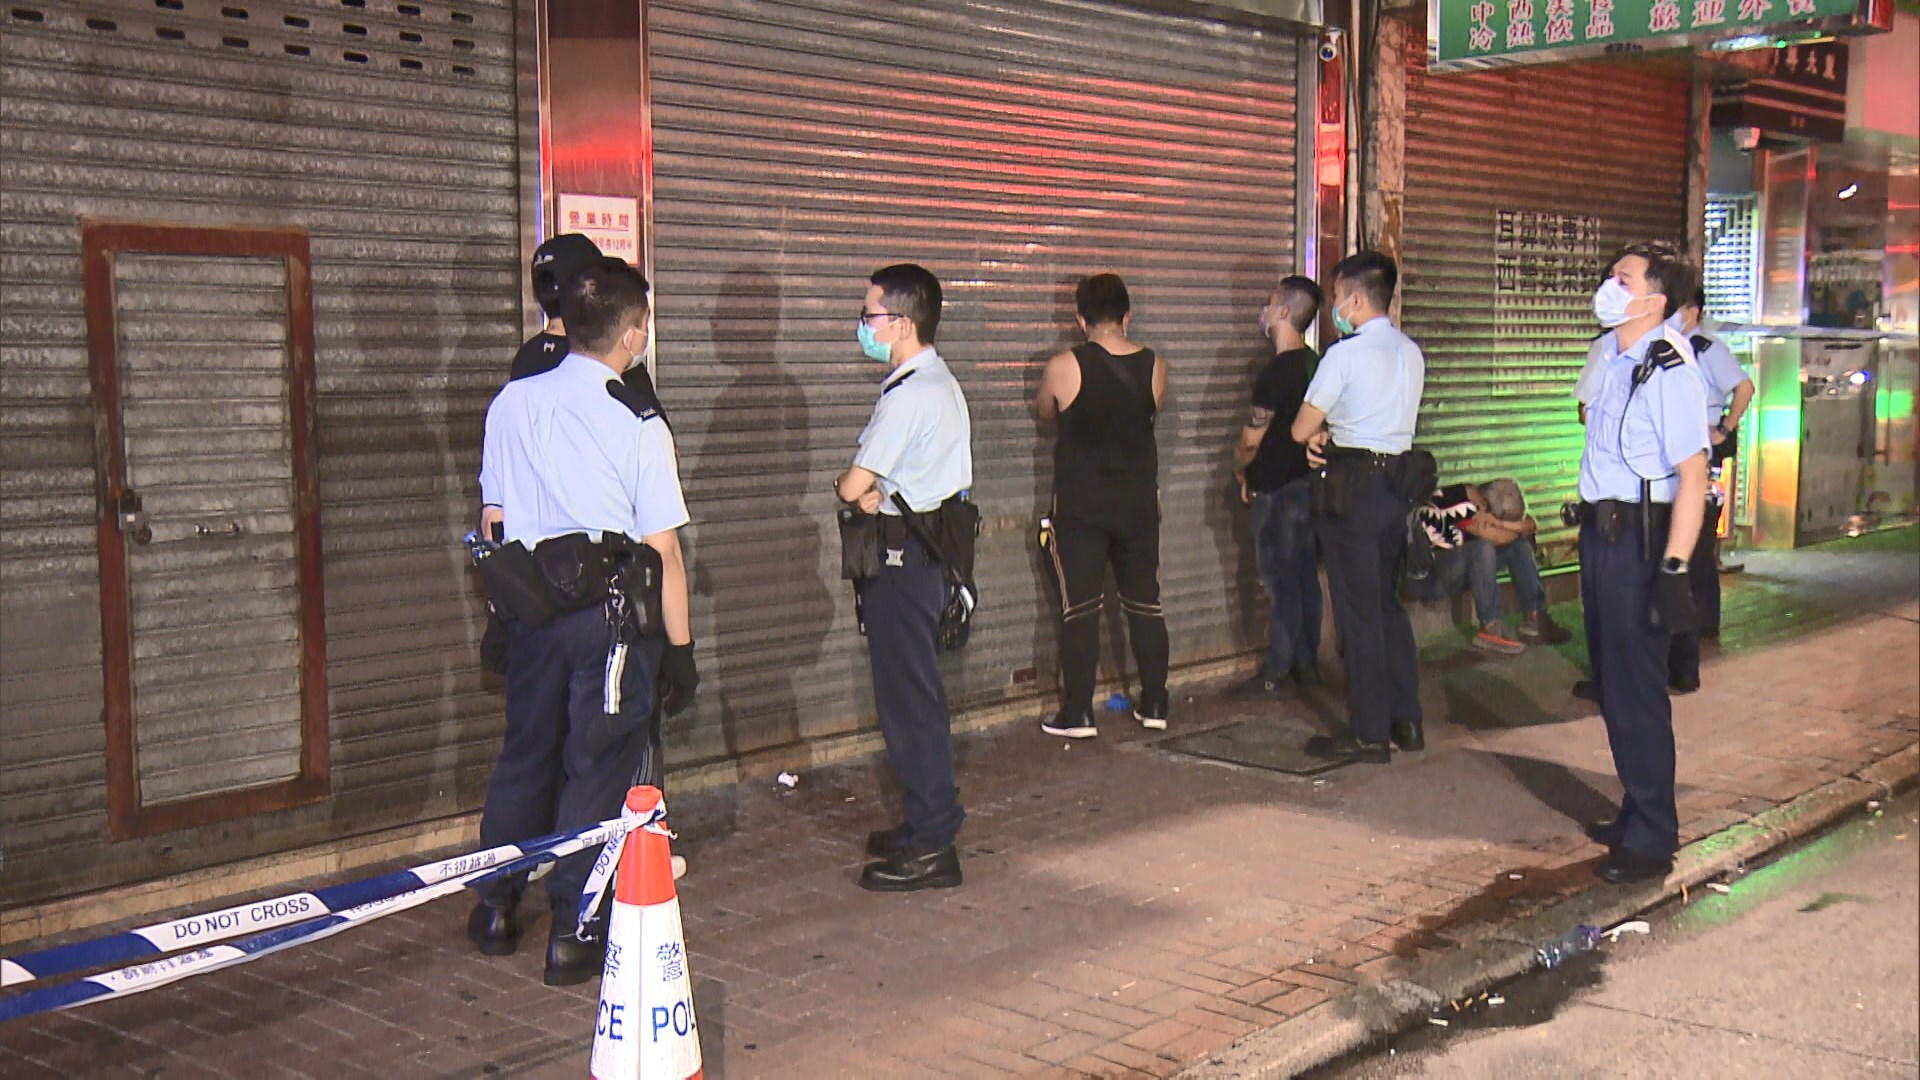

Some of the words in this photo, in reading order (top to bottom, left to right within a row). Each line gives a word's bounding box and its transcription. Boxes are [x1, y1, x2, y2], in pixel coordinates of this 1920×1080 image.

[1469, 11, 1615, 51] 冷熱飲品
[568, 210, 630, 229] 營業時間
[439, 851, 497, 877] 不得越過
[173, 921, 201, 940] DO
[205, 911, 241, 933] NOT
[251, 897, 310, 922] CROSS
